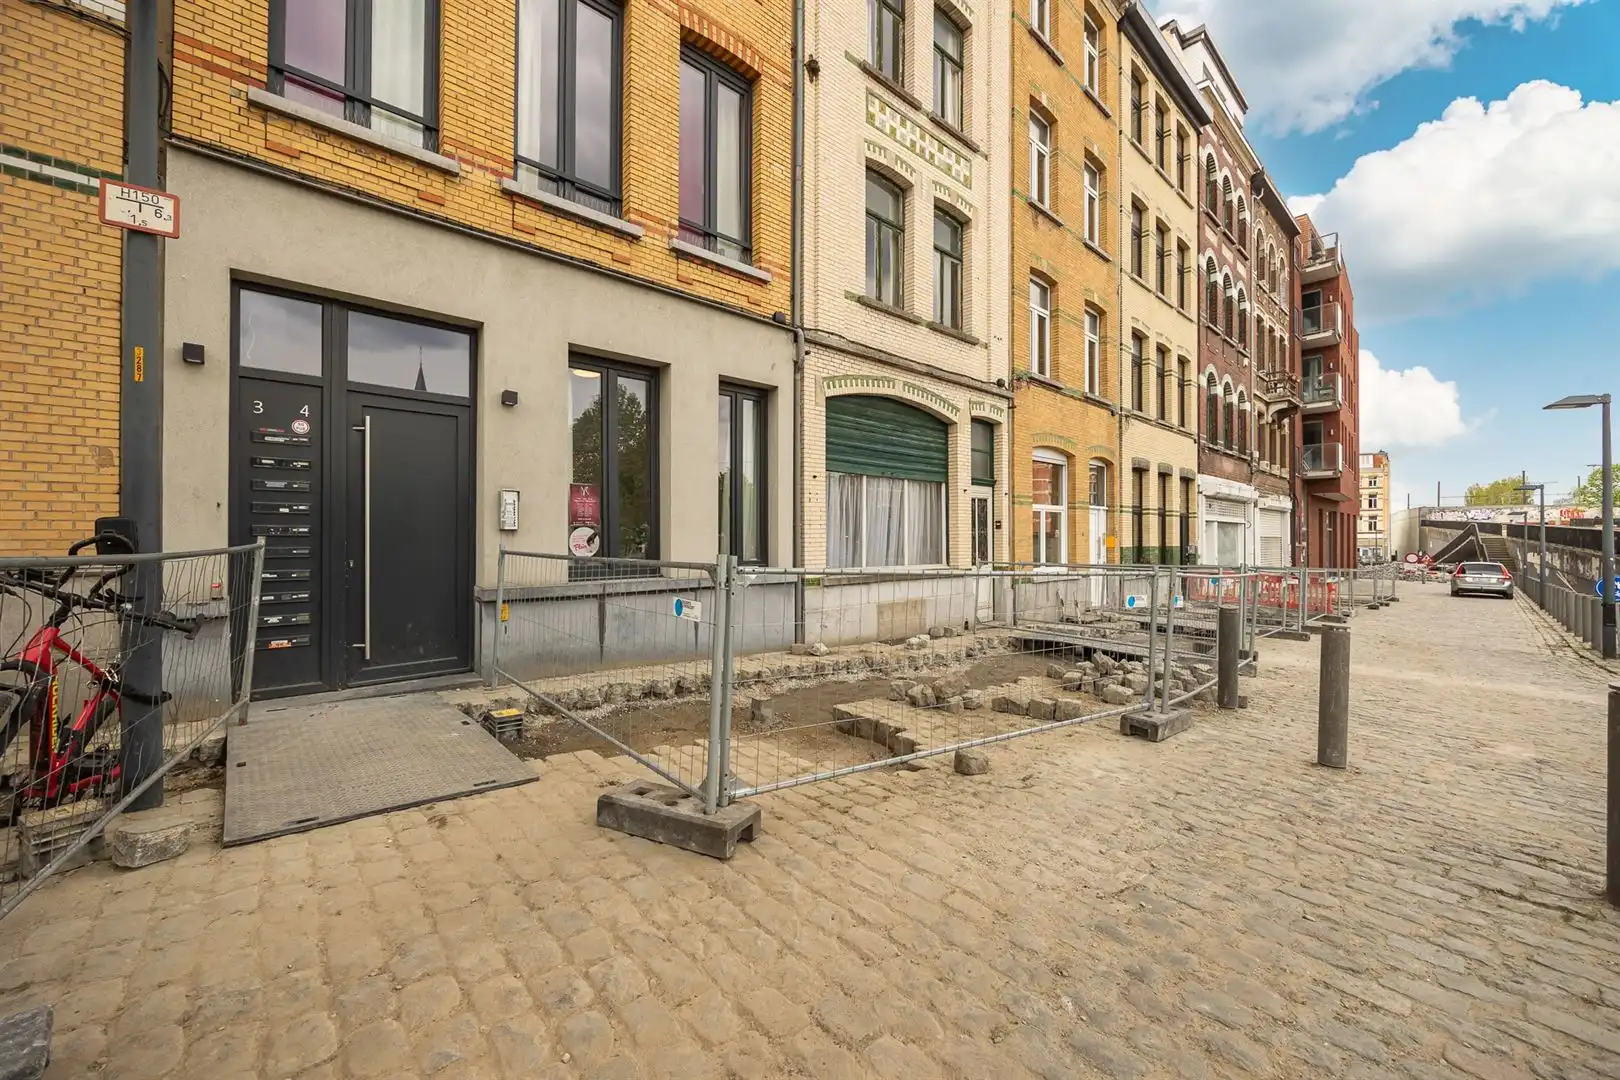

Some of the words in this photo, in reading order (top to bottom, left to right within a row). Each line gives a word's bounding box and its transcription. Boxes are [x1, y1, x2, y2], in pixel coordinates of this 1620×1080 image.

[121, 187, 160, 204] H150
[253, 400, 263, 414] 3
[299, 404, 309, 417] 4
